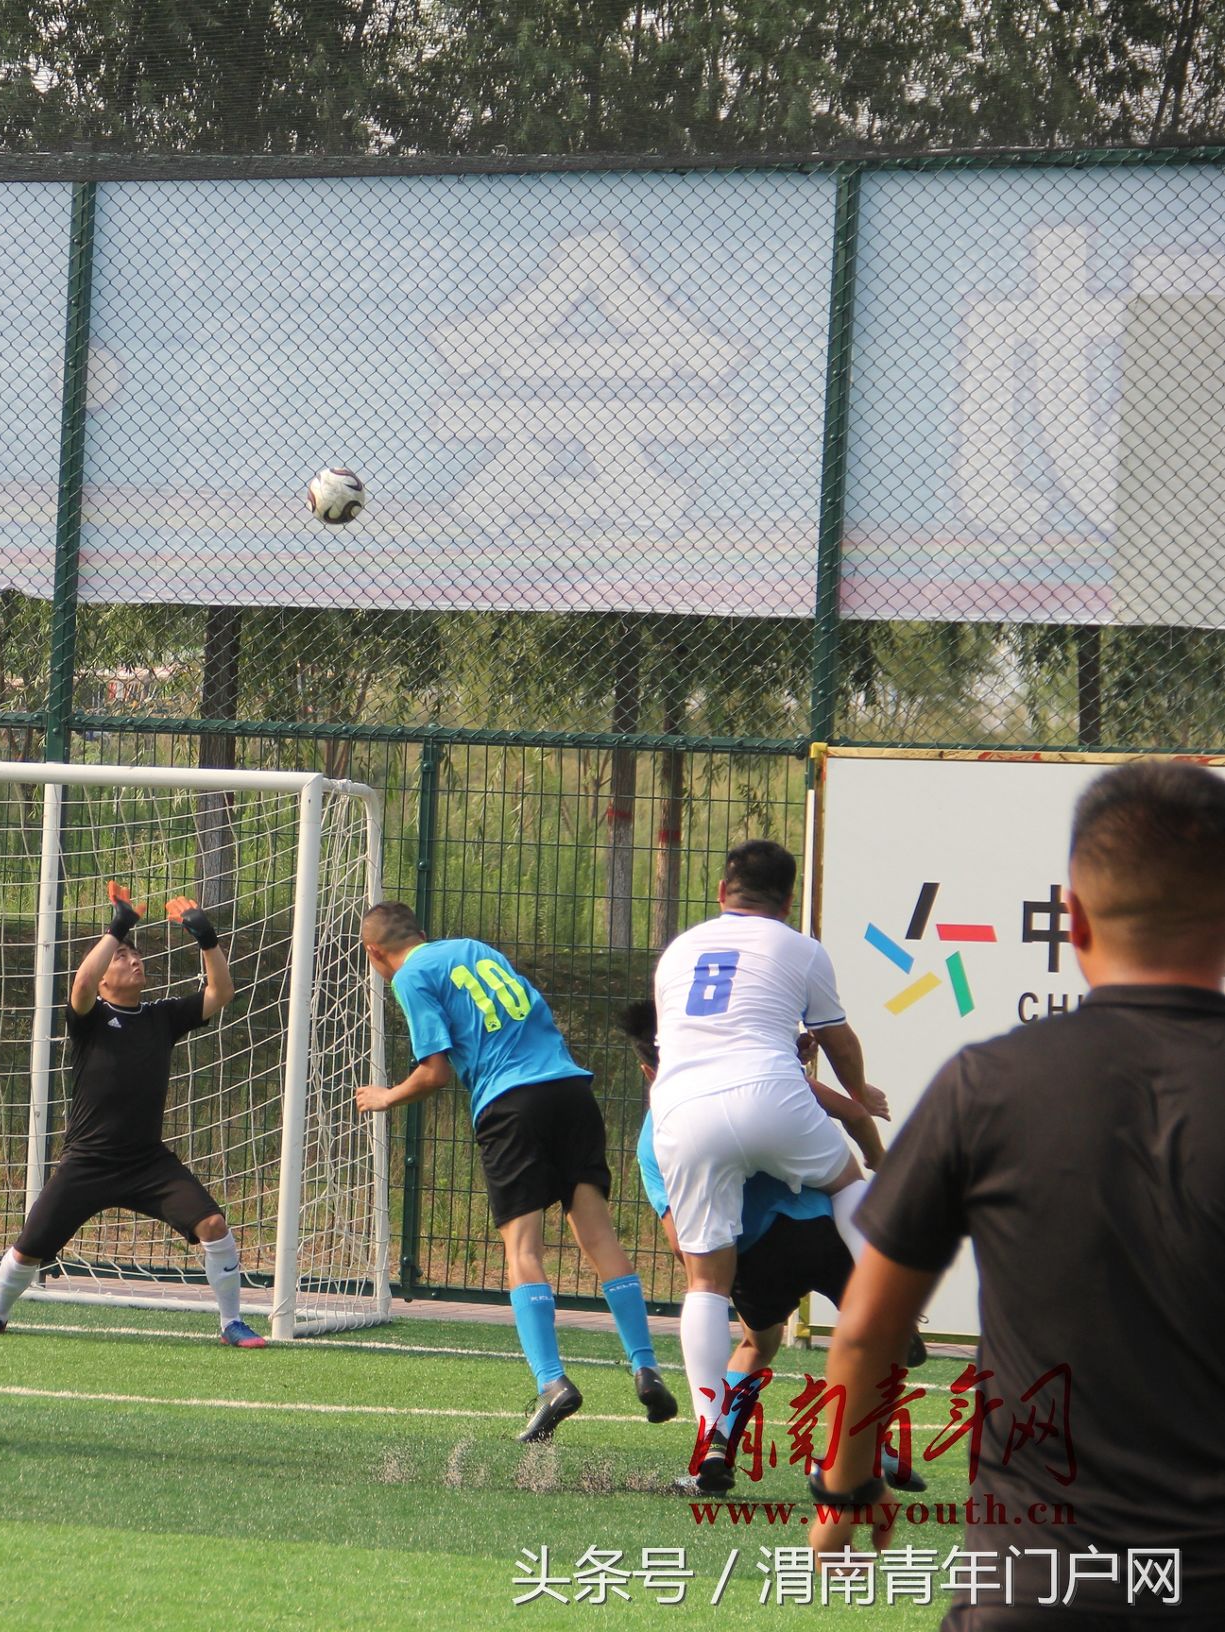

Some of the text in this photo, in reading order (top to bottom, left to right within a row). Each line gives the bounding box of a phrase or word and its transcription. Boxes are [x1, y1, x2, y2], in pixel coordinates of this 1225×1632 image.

[1022, 884, 1073, 973] 中
[450, 958, 533, 1033] 10
[686, 951, 740, 1017] 8
